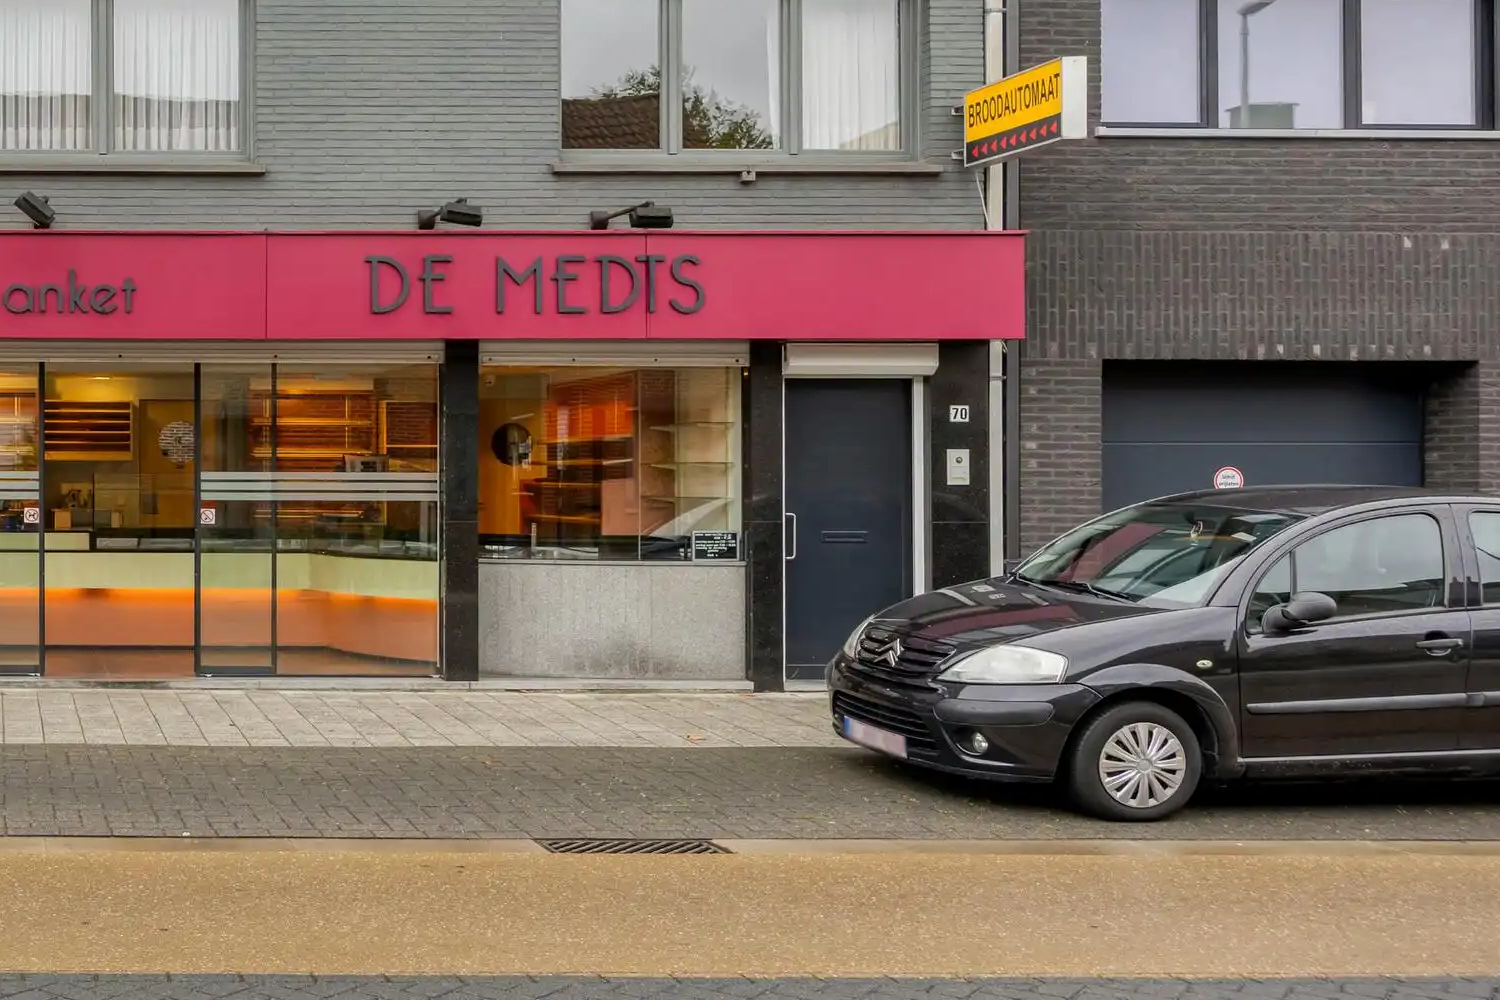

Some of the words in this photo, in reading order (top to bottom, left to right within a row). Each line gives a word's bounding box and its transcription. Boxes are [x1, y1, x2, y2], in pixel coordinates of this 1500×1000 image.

[968, 73, 1060, 128] BROODAUTOMAAT
[364, 254, 454, 315] DE
[494, 254, 706, 315] MEDTS
[951, 407, 968, 420] 70
